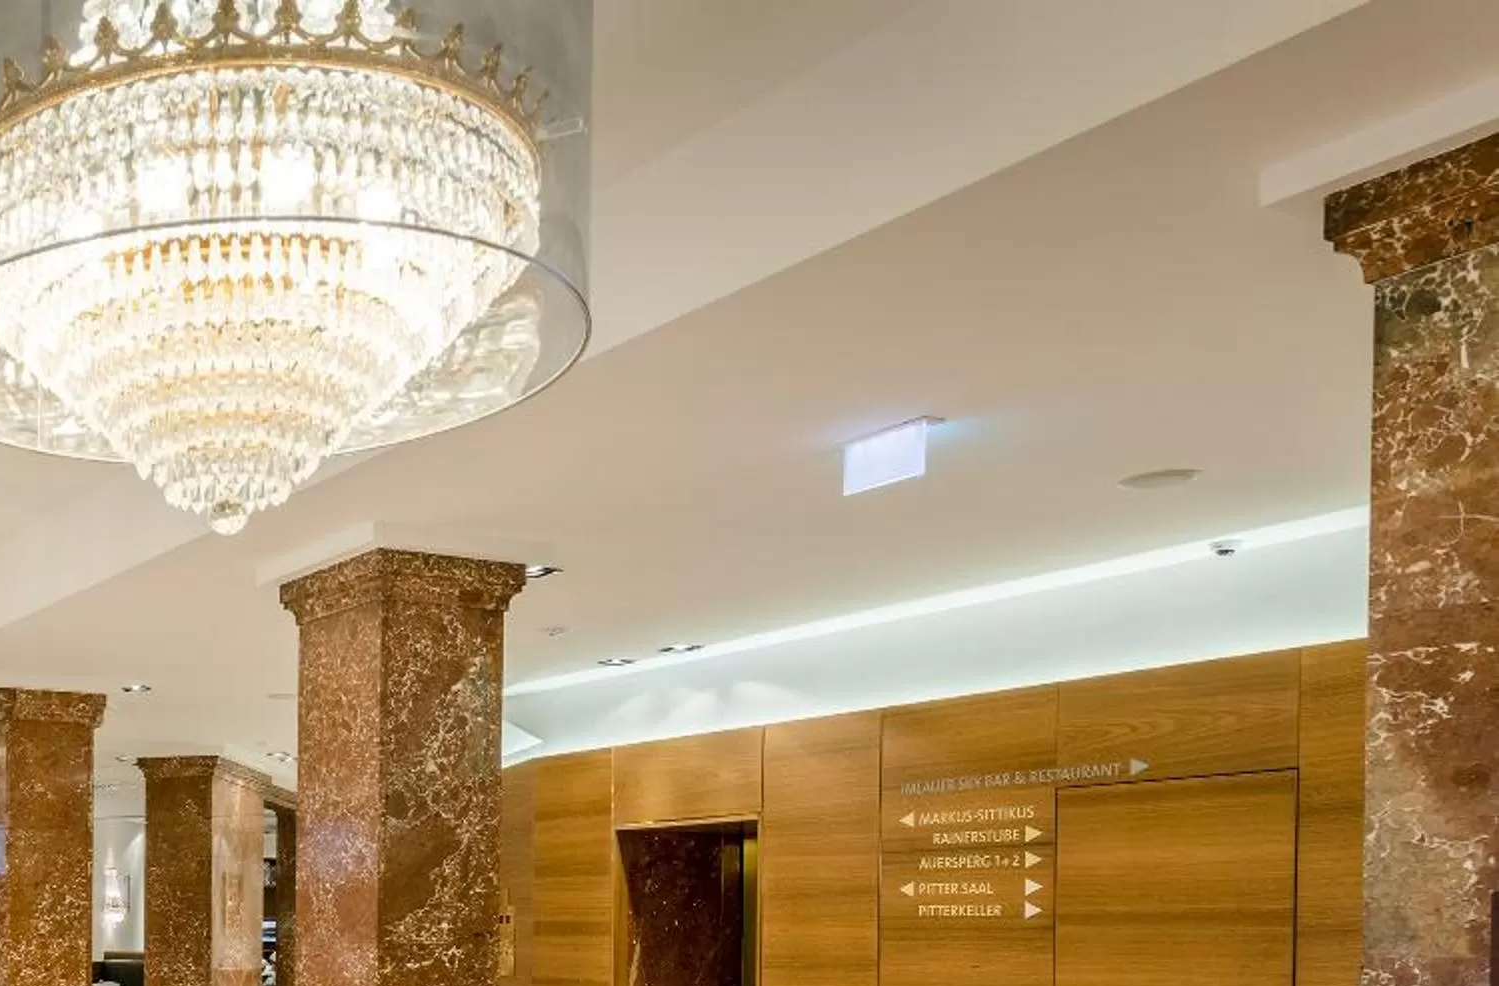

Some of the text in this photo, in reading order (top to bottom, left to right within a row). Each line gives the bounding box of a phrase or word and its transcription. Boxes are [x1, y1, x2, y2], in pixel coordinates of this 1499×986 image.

[985, 772, 1010, 787] BAR
[1014, 770, 1026, 784] &
[1030, 762, 1121, 783] RESTAURANT
[918, 805, 1035, 826] MARKUS-SITTIKUS
[932, 829, 1021, 845] RAINERSTUBE
[918, 855, 991, 870] AUERSPERG
[918, 881, 994, 895] PITTER SAAL
[917, 903, 1002, 917] PITTERKELLER
